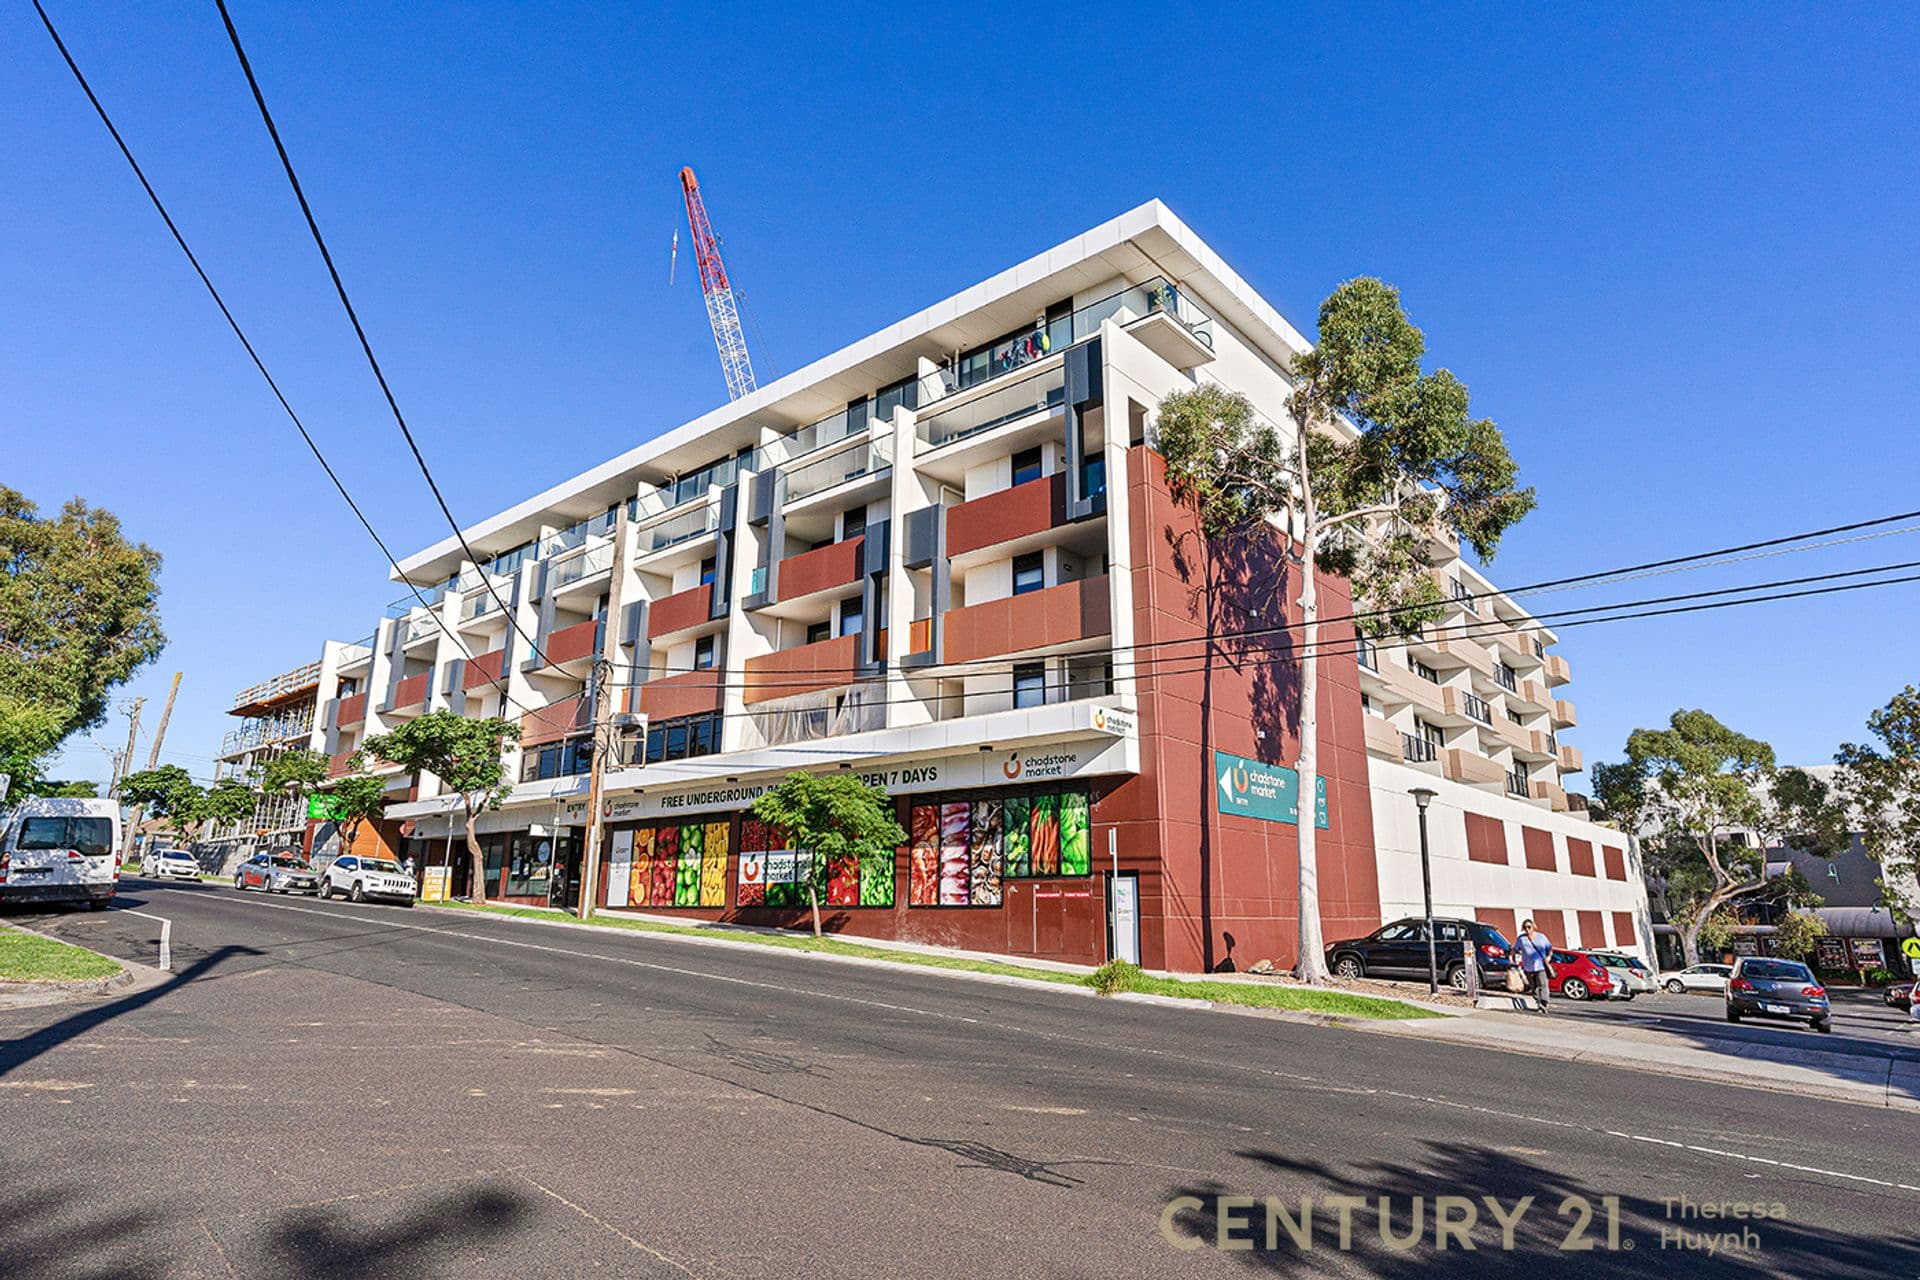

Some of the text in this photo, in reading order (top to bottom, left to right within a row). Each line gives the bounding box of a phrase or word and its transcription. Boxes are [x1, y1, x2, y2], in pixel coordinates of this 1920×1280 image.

[1025, 753, 1077, 767] chadstone
[891, 771, 898, 785] 7
[902, 766, 937, 784] DAYS
[1025, 765, 1062, 777] market
[1249, 769, 1286, 789] chadstone
[661, 795, 685, 808] FREE
[686, 786, 763, 806] UNDERGROUND
[1250, 784, 1277, 799] market
